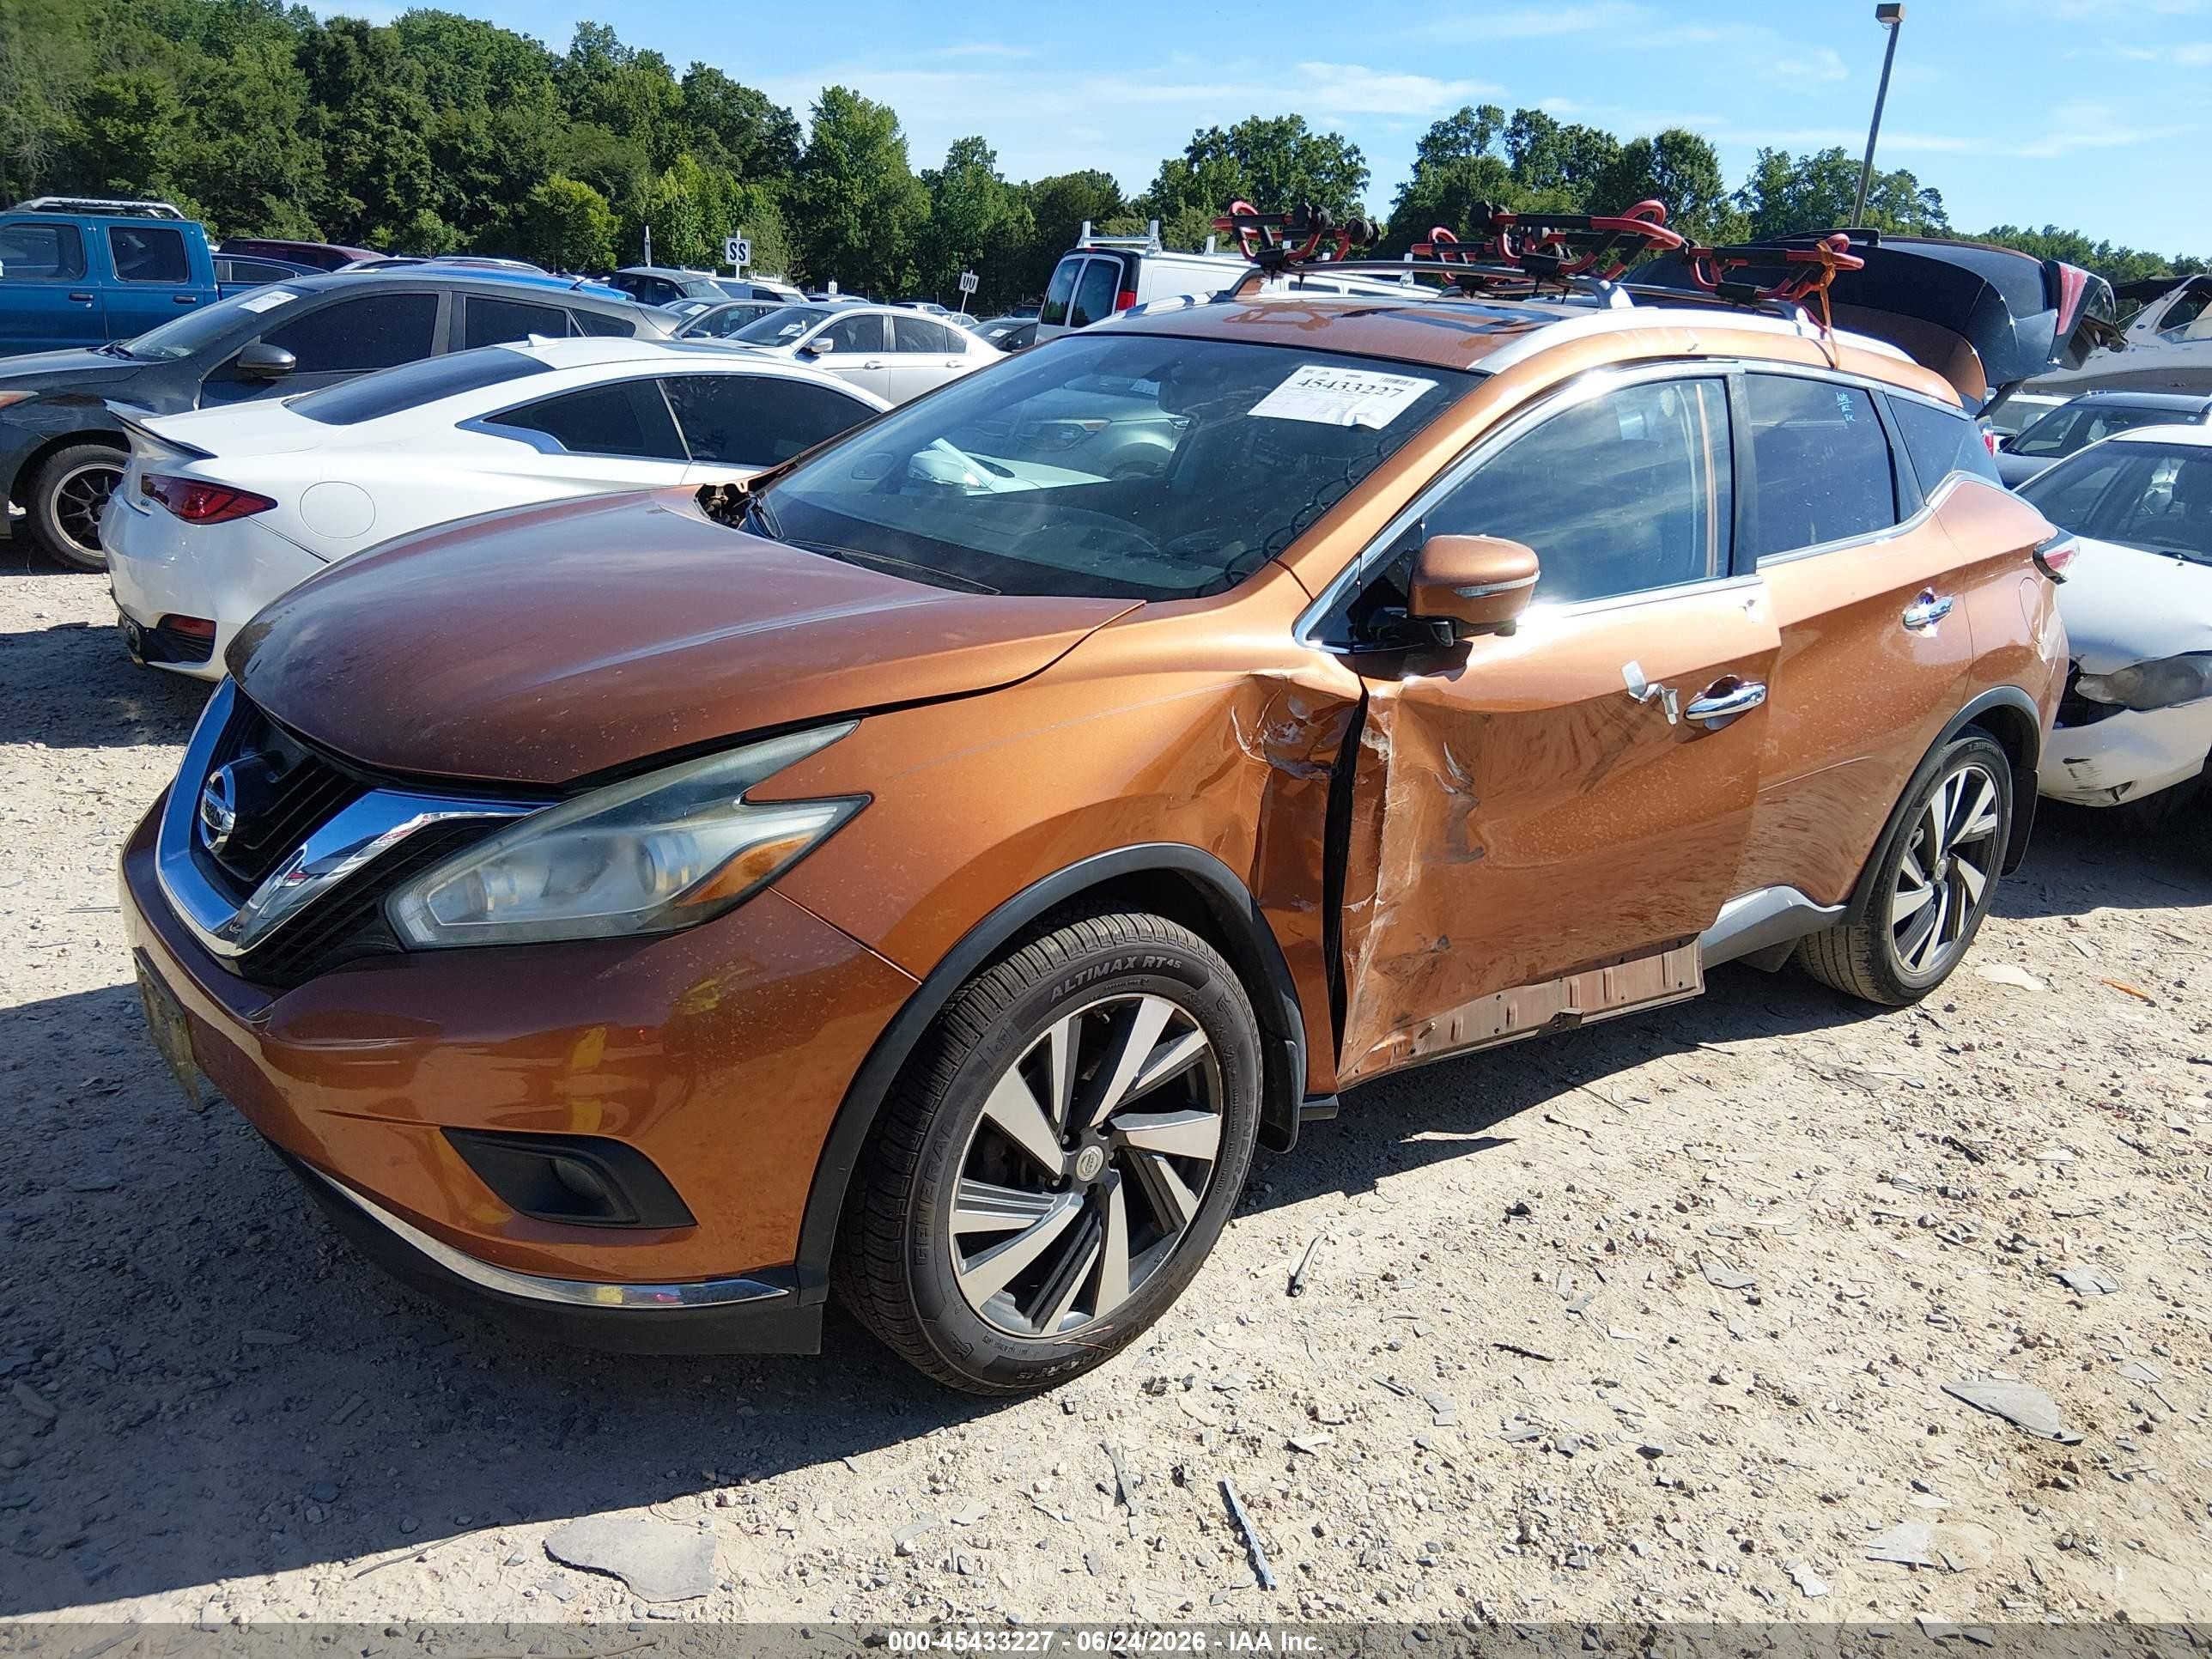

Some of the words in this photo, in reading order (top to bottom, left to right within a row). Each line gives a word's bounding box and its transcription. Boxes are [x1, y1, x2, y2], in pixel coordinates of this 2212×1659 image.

[729, 241, 746, 261] SS
[963, 275, 976, 290] UU
[1297, 378, 1405, 398] 45433227
[1050, 956, 1138, 1003] ALTIMAX
[1142, 955, 1182, 969] RT45
[914, 1121, 952, 1266] GENERAL
